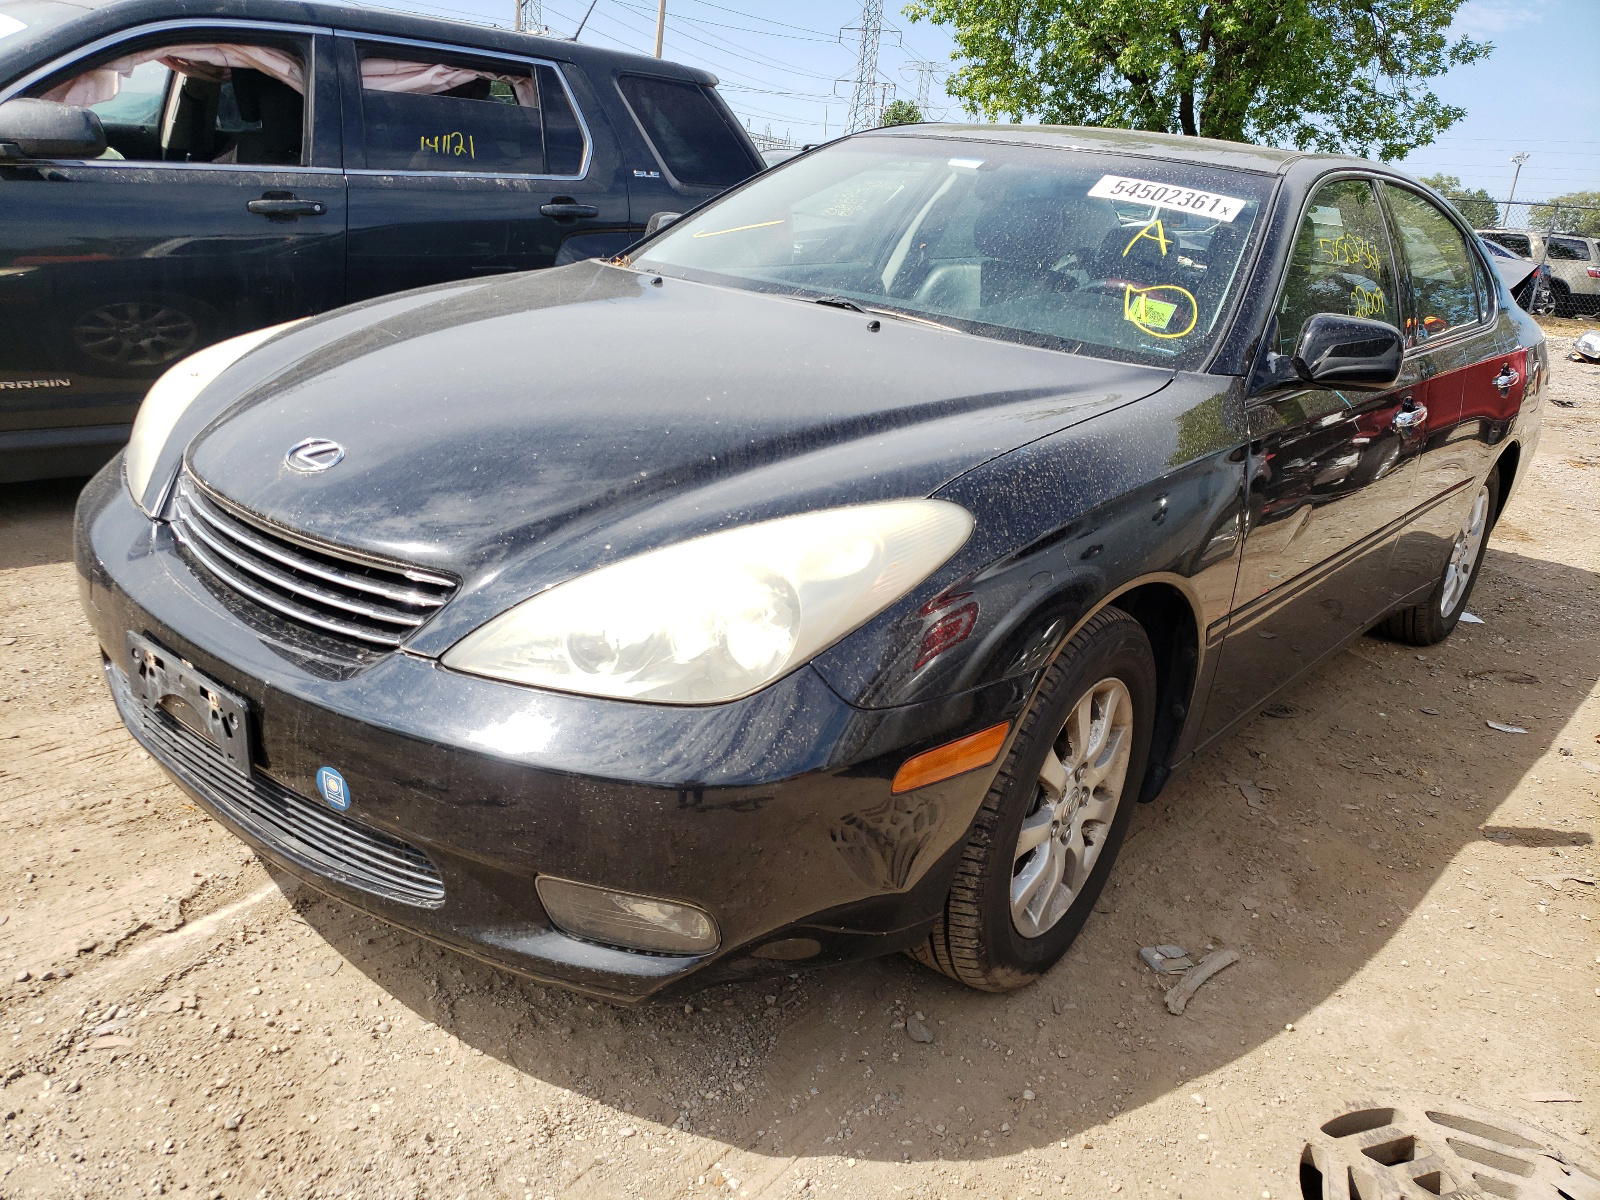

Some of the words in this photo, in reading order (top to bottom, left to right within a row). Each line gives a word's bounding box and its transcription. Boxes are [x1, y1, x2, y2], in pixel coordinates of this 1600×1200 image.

[420, 131, 475, 160] 141121
[1110, 180, 1221, 213] 54502361
[1122, 219, 1174, 257] A
